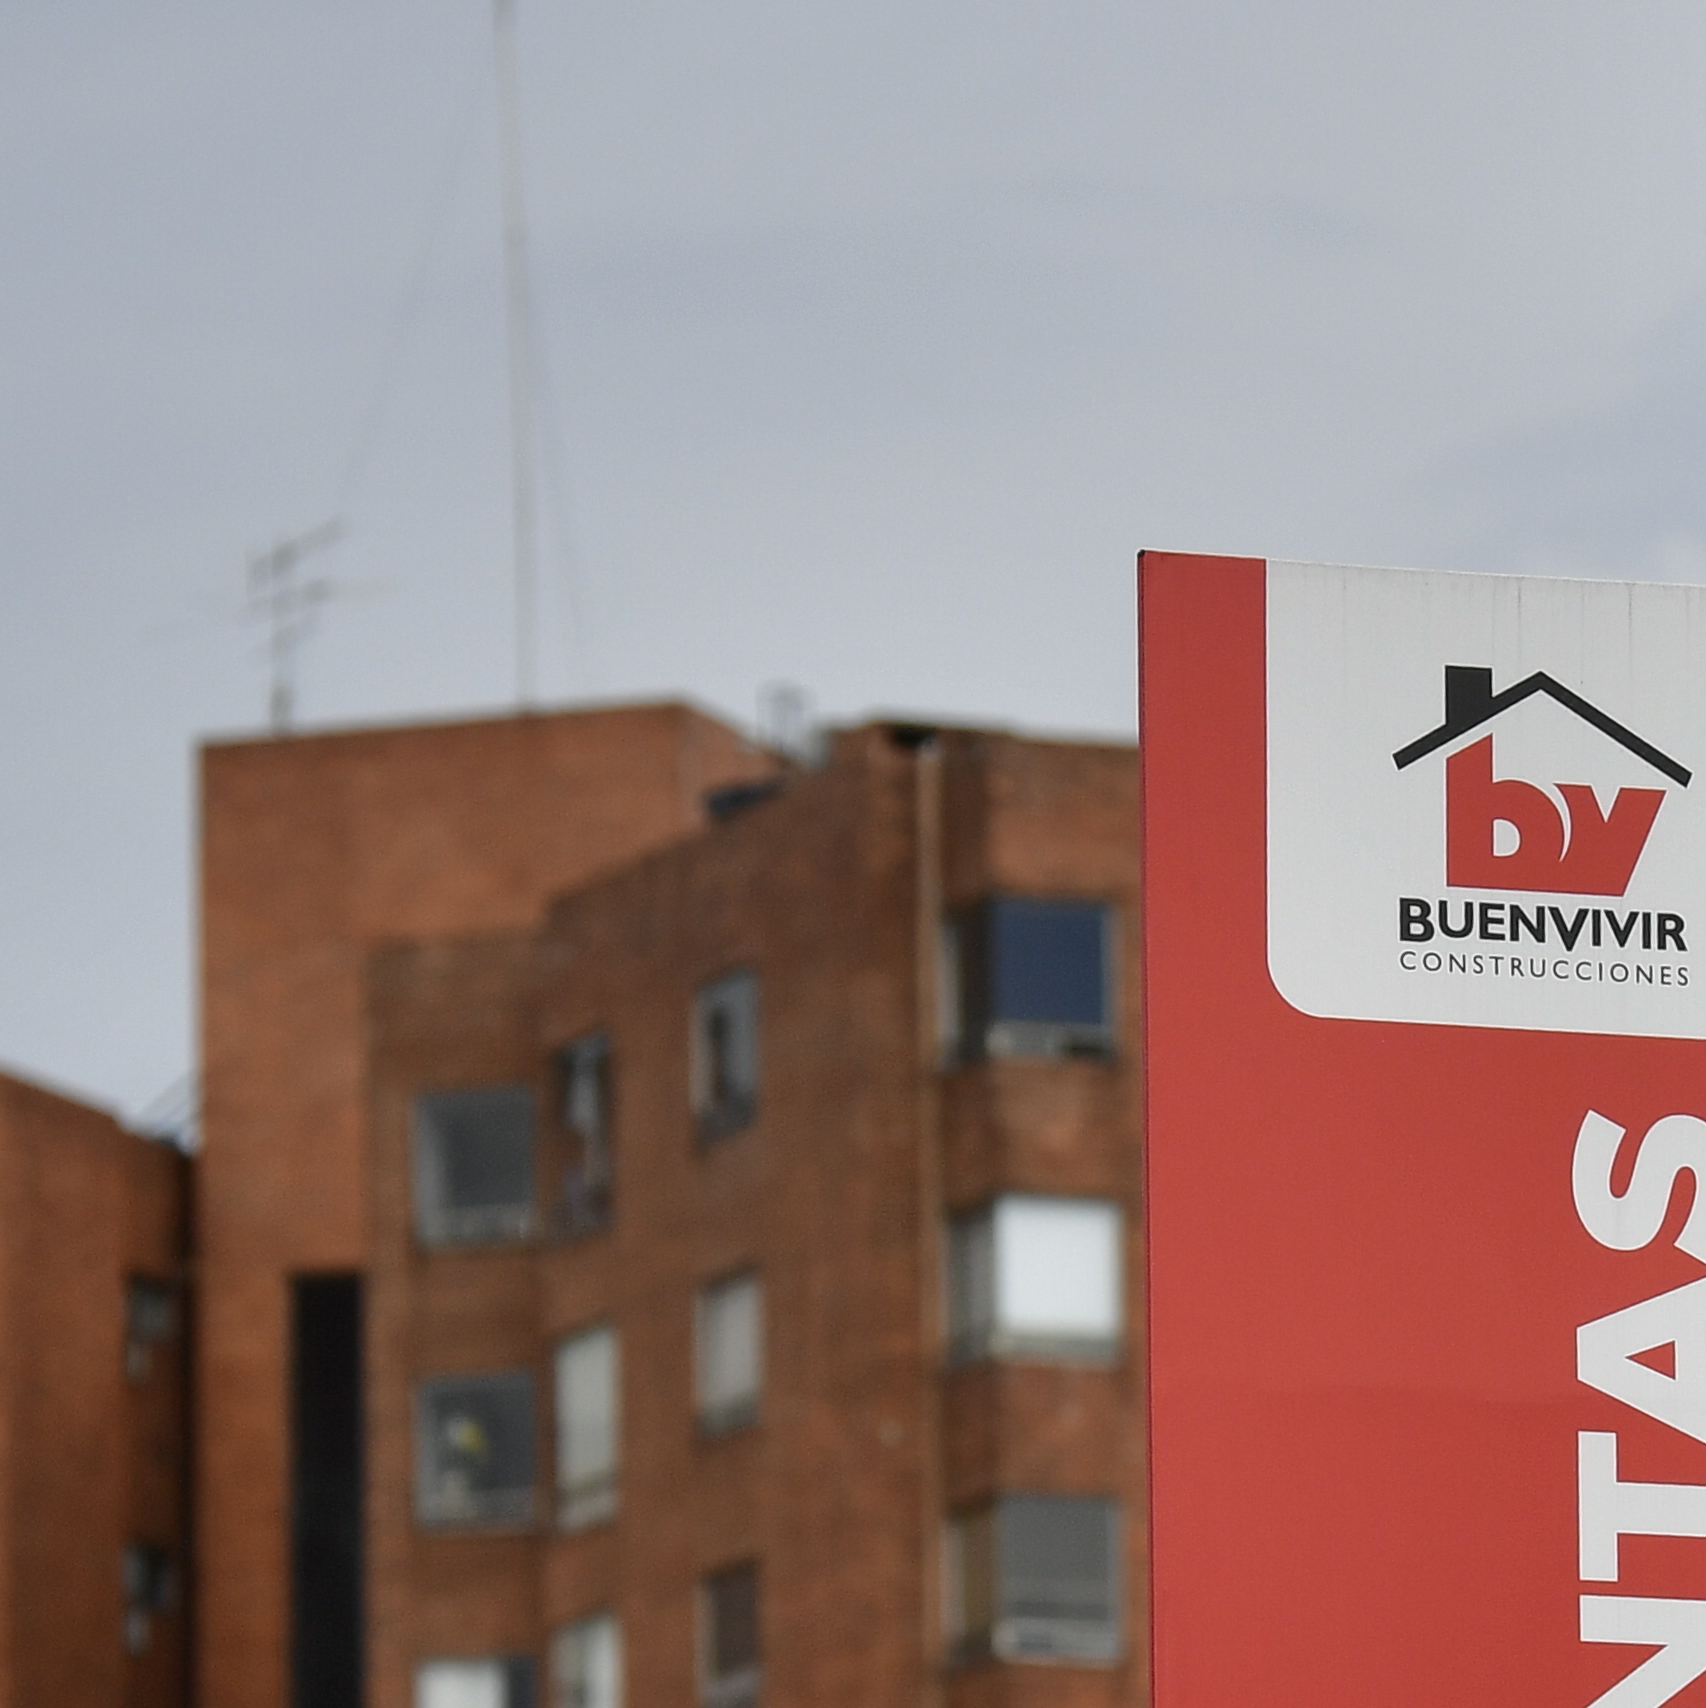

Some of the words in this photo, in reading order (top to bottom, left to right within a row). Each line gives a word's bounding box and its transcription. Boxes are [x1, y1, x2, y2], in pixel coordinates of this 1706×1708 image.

[1446, 733, 1666, 897] bv
[1398, 896, 1689, 953] BUENVIVIR
[1398, 950, 1690, 987] CONSTRUCCIONES
